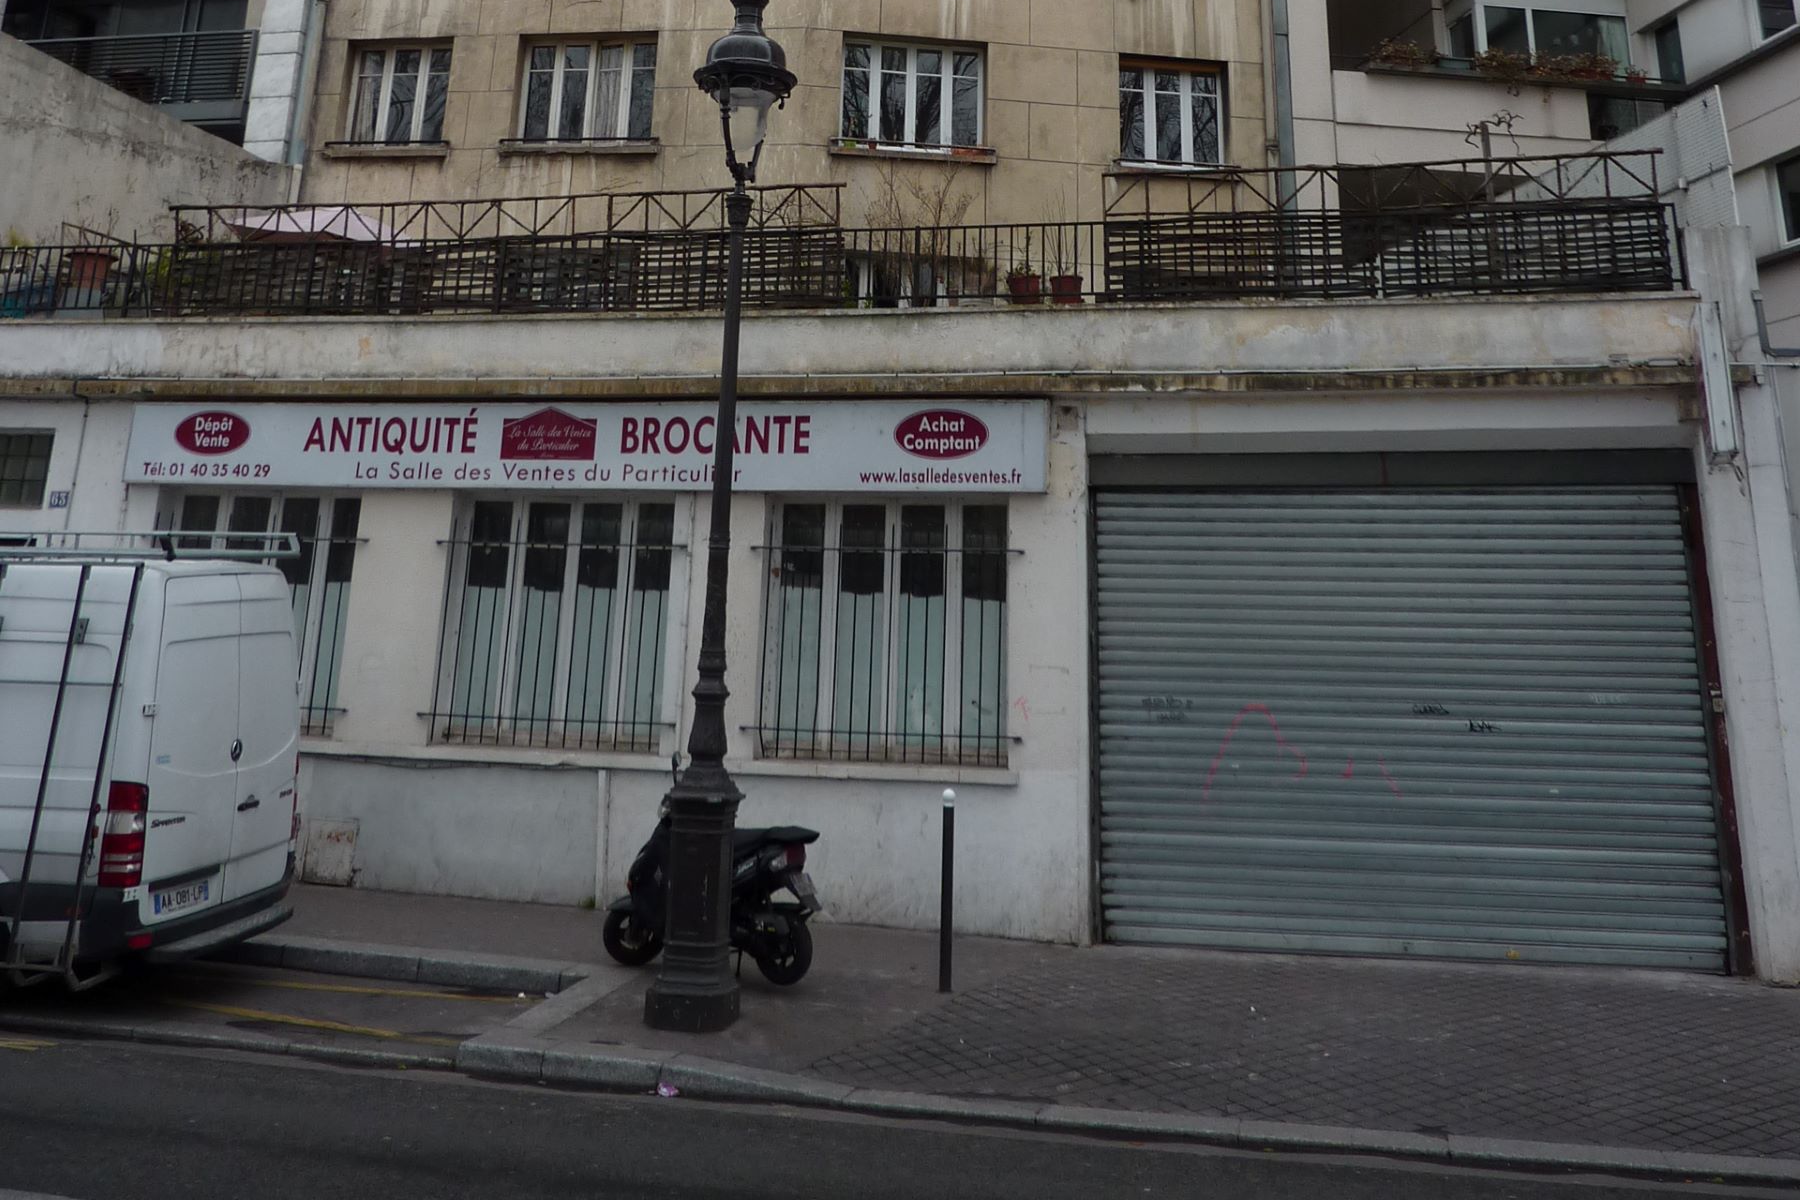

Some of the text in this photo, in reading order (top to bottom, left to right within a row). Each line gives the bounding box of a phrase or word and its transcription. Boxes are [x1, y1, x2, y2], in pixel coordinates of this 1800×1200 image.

[195, 417, 233, 434] Dépôt
[303, 408, 478, 455] ANTIQUITÉ
[919, 416, 965, 433] Achat
[194, 433, 230, 448] Vente
[620, 416, 811, 455] BROCNTE
[903, 433, 980, 454] Comptant
[143, 462, 271, 479] Tél: 01 40 35 40 29
[355, 461, 742, 483] La Salle des Ventes du Particulir
[860, 467, 1022, 485] www.lasalledesventes.fr
